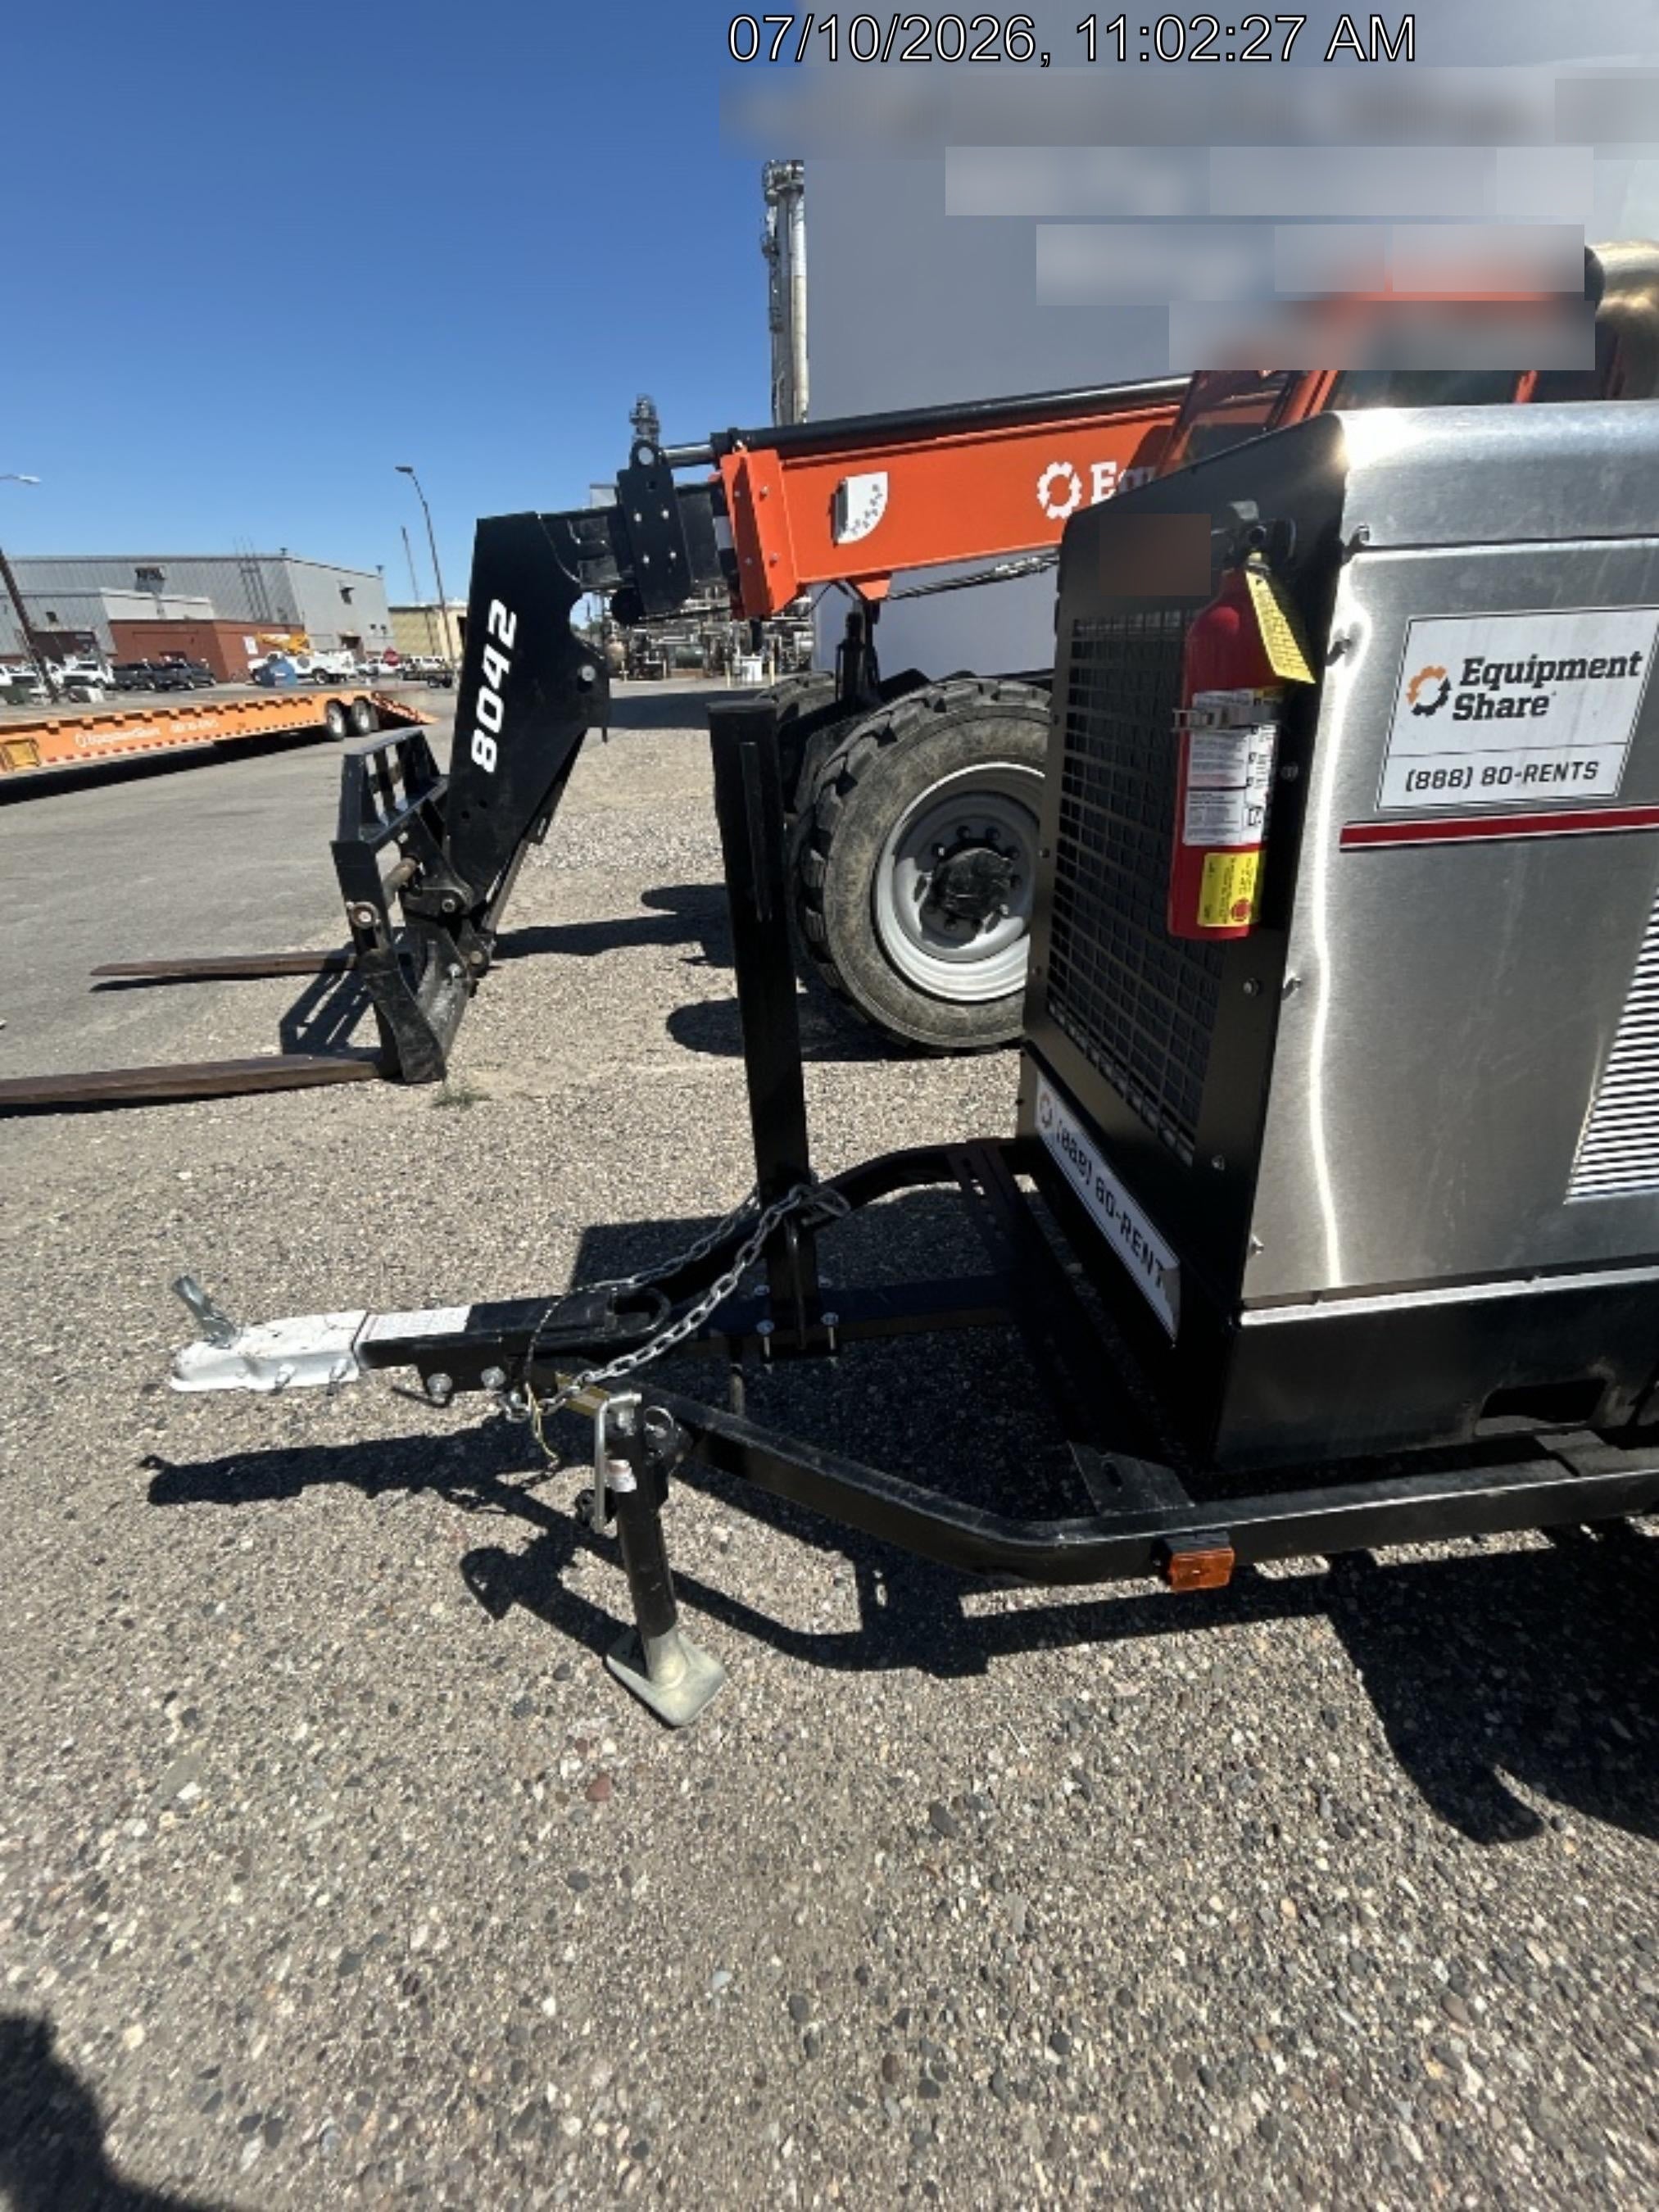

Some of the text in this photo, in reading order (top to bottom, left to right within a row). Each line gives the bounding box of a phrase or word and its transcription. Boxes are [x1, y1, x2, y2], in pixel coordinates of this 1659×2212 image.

[471, 599, 517, 773] 8042
[1459, 650, 1643, 691] Equipment
[1452, 693, 1551, 721] Share
[1405, 761, 1599, 791] (888) 80-RENTS
